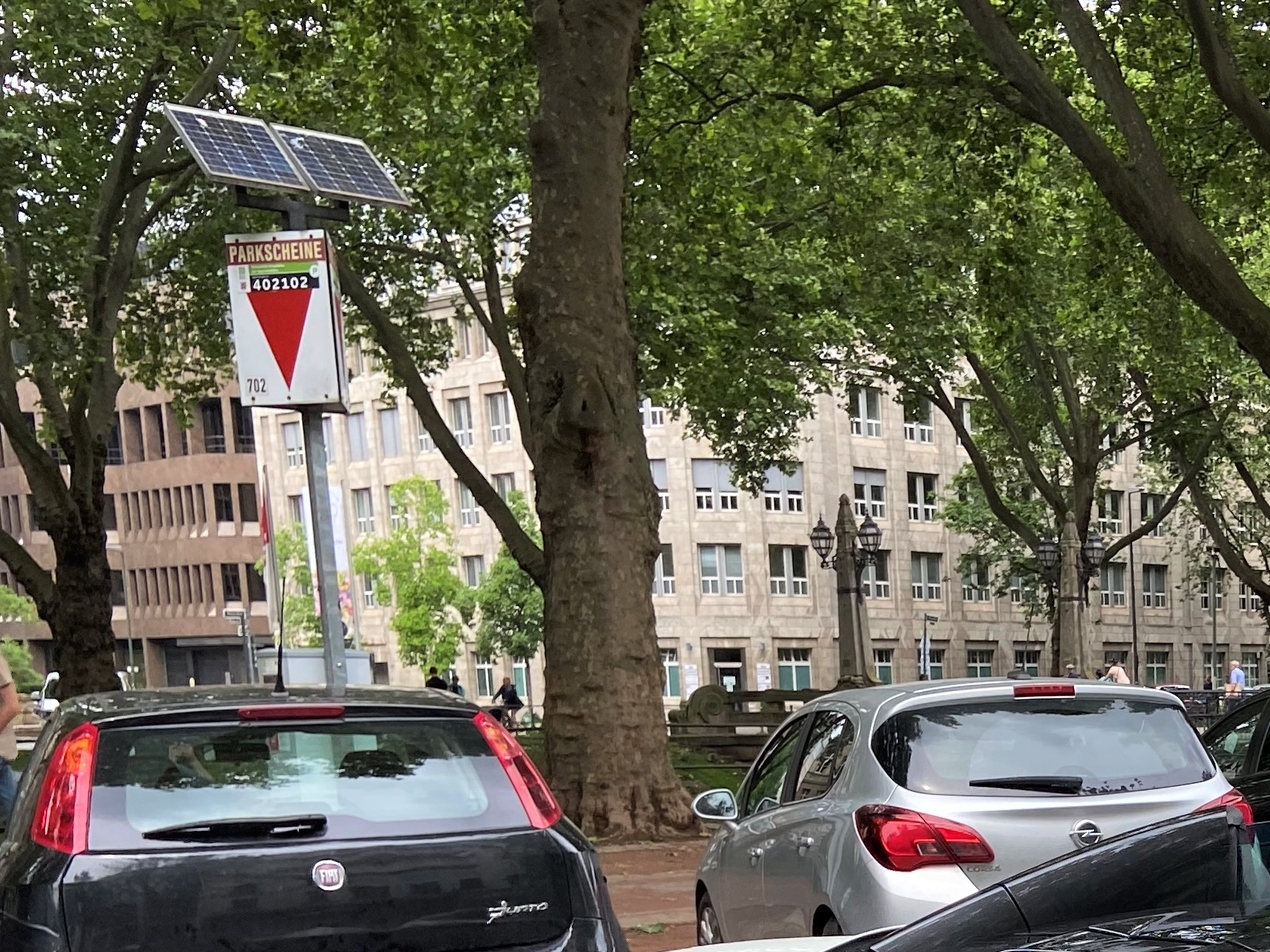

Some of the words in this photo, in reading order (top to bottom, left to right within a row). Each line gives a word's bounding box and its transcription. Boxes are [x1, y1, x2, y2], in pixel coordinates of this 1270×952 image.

[229, 241, 322, 263] PARKSCHEINE
[253, 276, 308, 291] 402102
[247, 378, 266, 393] 702
[320, 868, 338, 884] FIAT
